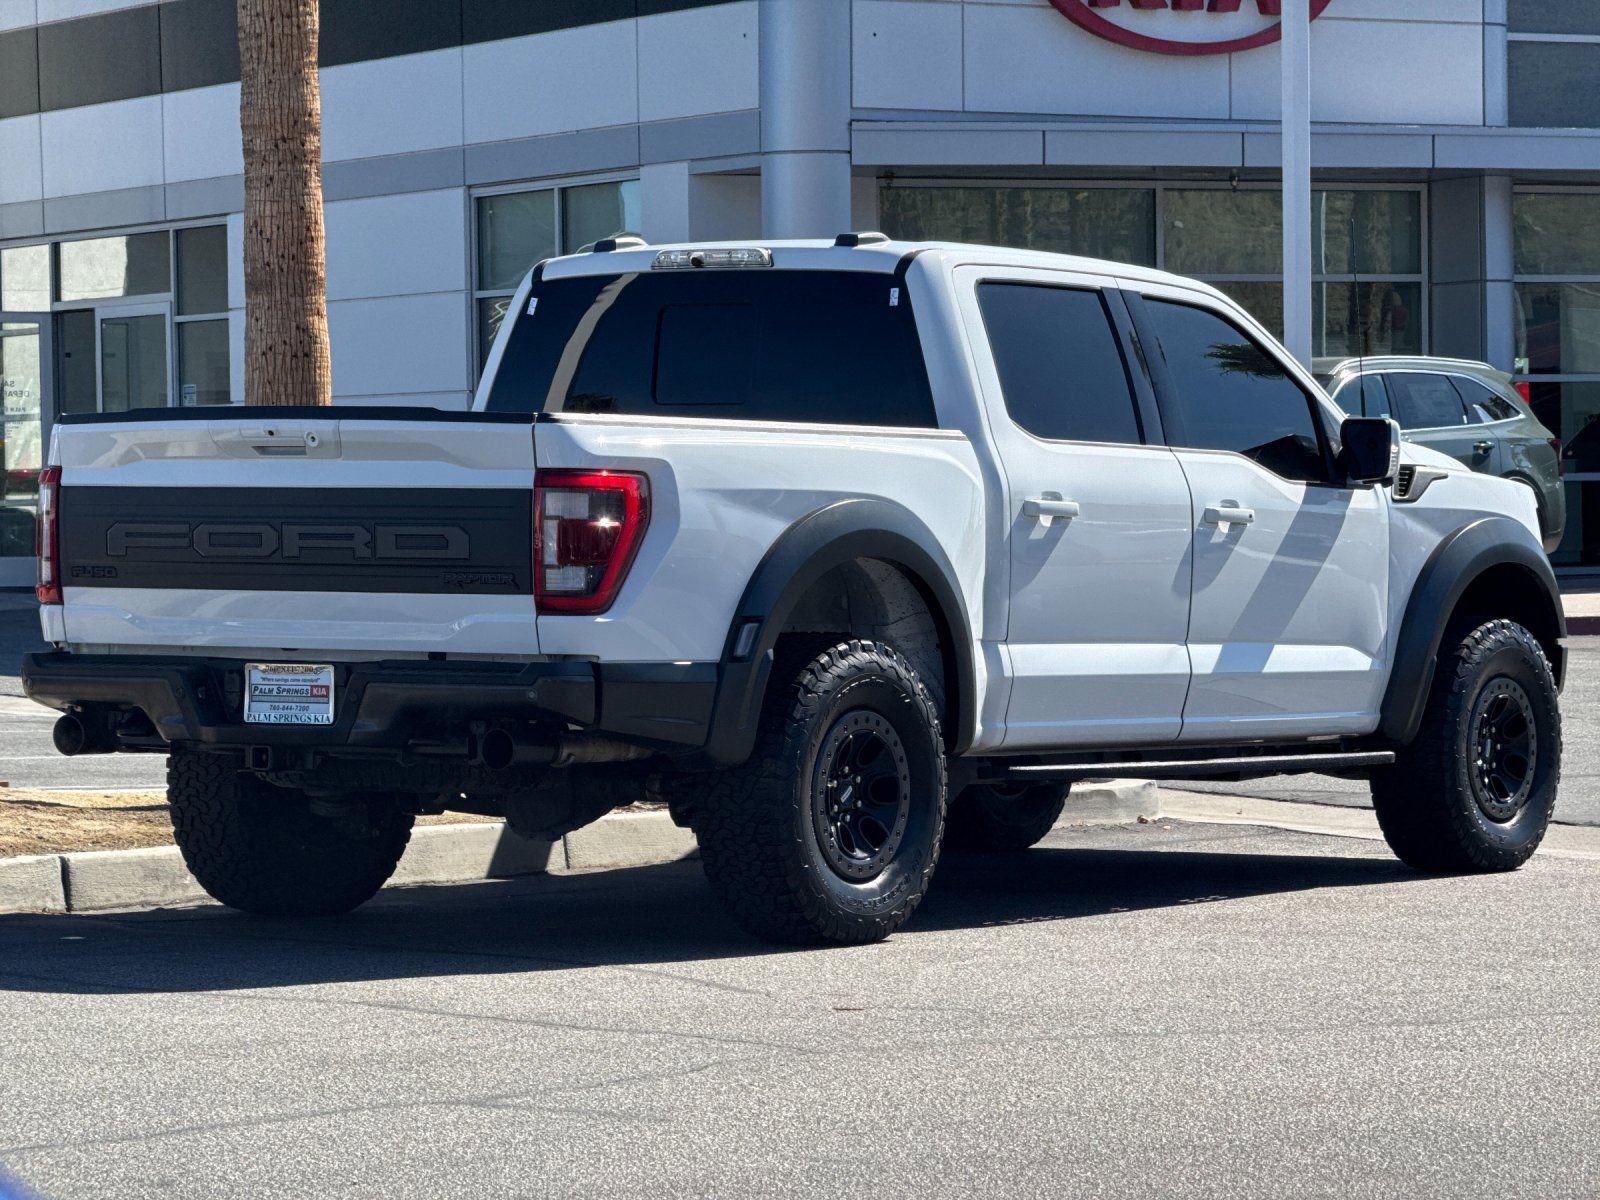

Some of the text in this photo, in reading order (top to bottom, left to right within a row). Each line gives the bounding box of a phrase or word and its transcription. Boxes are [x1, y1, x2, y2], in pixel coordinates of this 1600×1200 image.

[106, 520, 471, 561] FORD
[441, 571, 521, 590] RAPTOR
[253, 686, 327, 696] PALM SPRINGS KIA
[269, 704, 310, 712] 760-844-7200
[247, 714, 331, 723] PALM SPRINGS KIA
